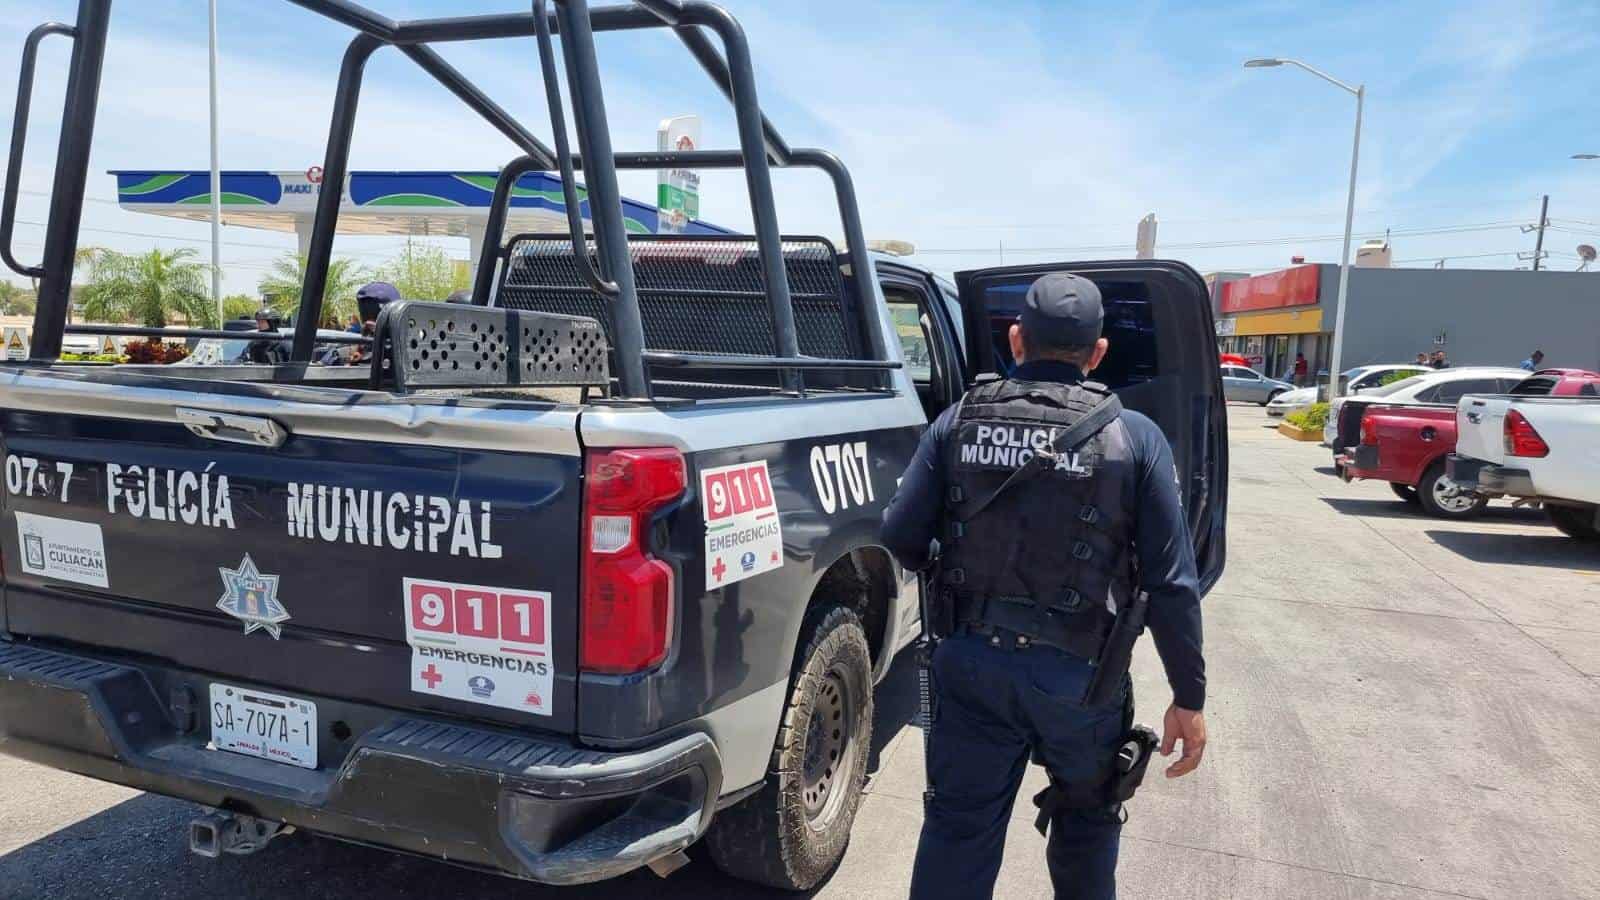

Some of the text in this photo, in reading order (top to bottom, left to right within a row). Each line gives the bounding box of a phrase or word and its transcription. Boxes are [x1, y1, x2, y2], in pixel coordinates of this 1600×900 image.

[810, 441, 875, 514] 0707
[961, 444, 1085, 473] MUNICAL
[106, 461, 503, 559] POLICÍA MUNICIPAL
[711, 471, 768, 514] 911
[709, 522, 778, 553] EMERGENCIAS
[420, 593, 530, 637] 911
[418, 646, 548, 676] EMERGENCIAS
[214, 702, 310, 747] SA-707A-1
